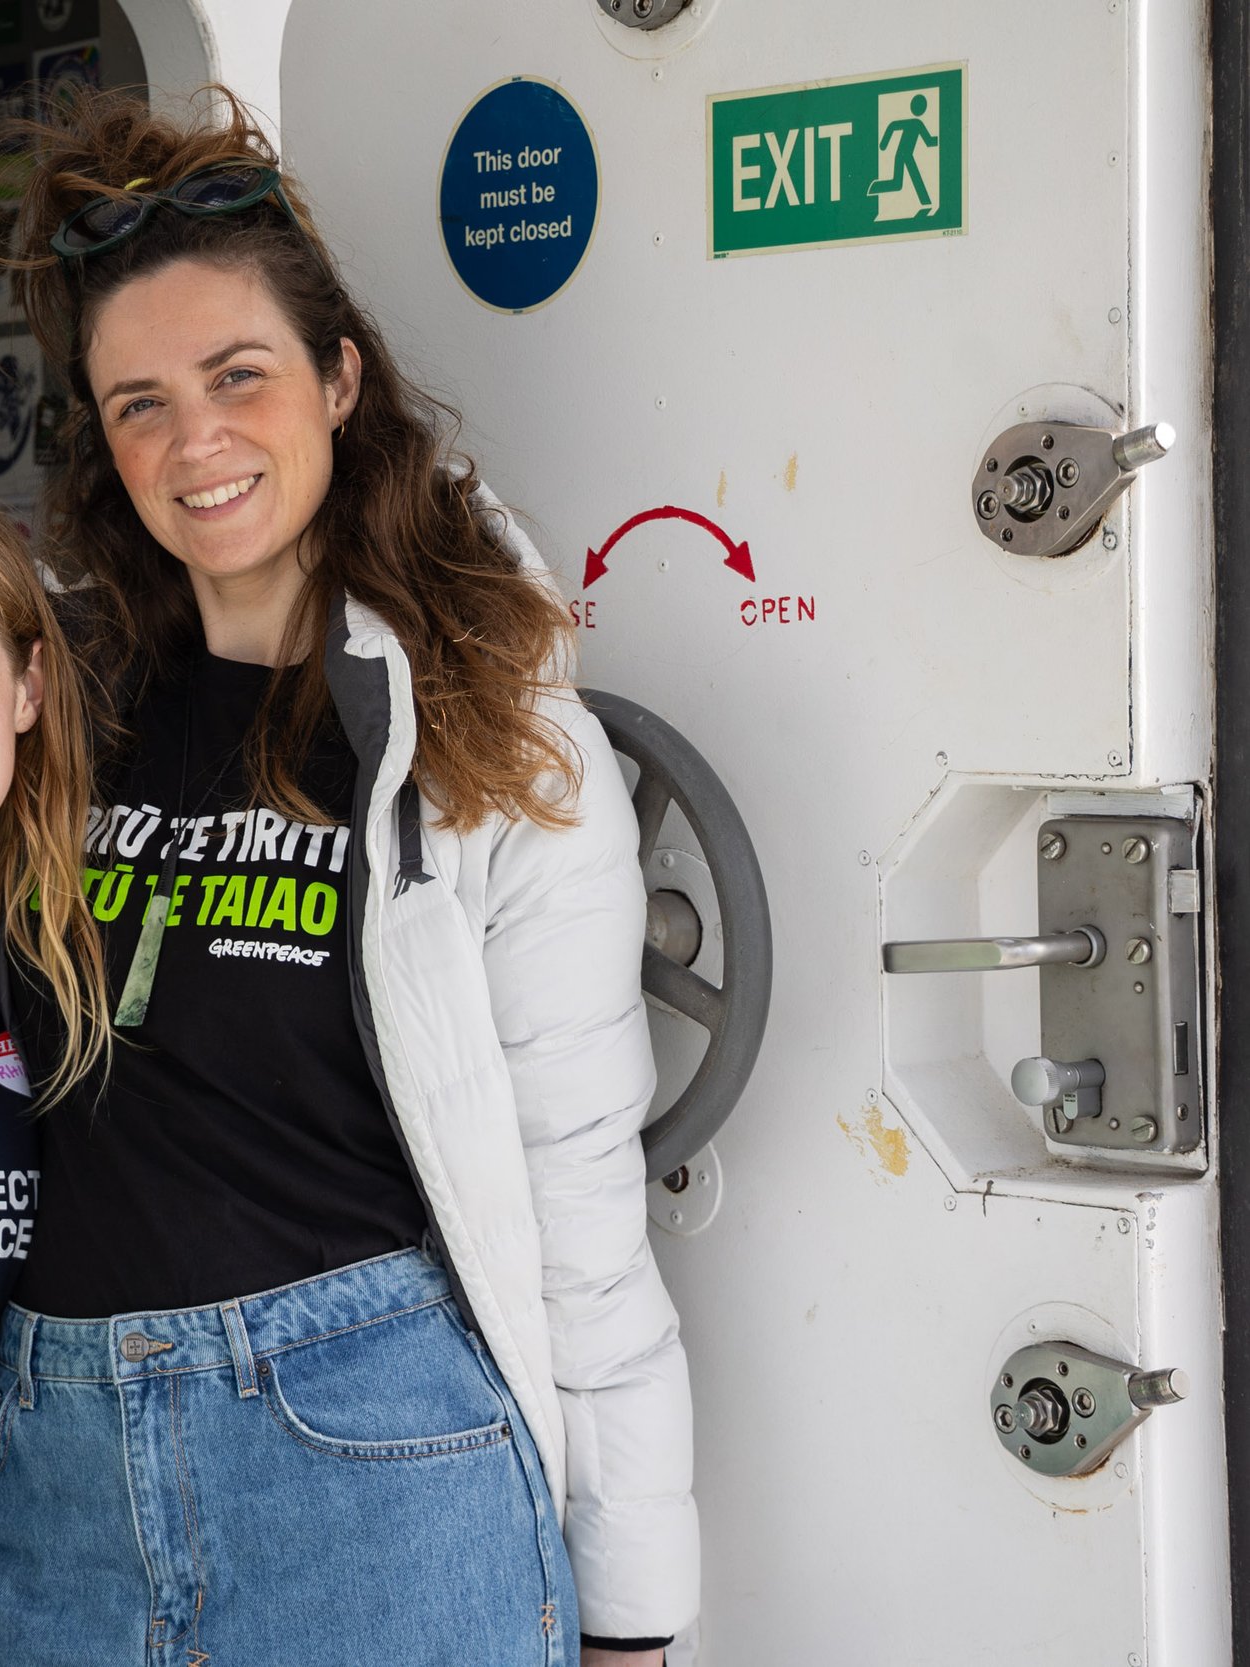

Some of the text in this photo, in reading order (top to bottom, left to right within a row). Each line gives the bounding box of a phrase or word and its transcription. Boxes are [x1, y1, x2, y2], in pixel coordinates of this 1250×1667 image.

[473, 146, 562, 173] This door
[732, 122, 853, 213] EXIT
[480, 182, 556, 209] must be
[465, 215, 572, 249] kept closed
[740, 596, 815, 626] OPEN
[216, 808, 350, 873] TIRITI
[196, 875, 338, 936] TAIAO
[208, 938, 331, 967] GREENPEACE
